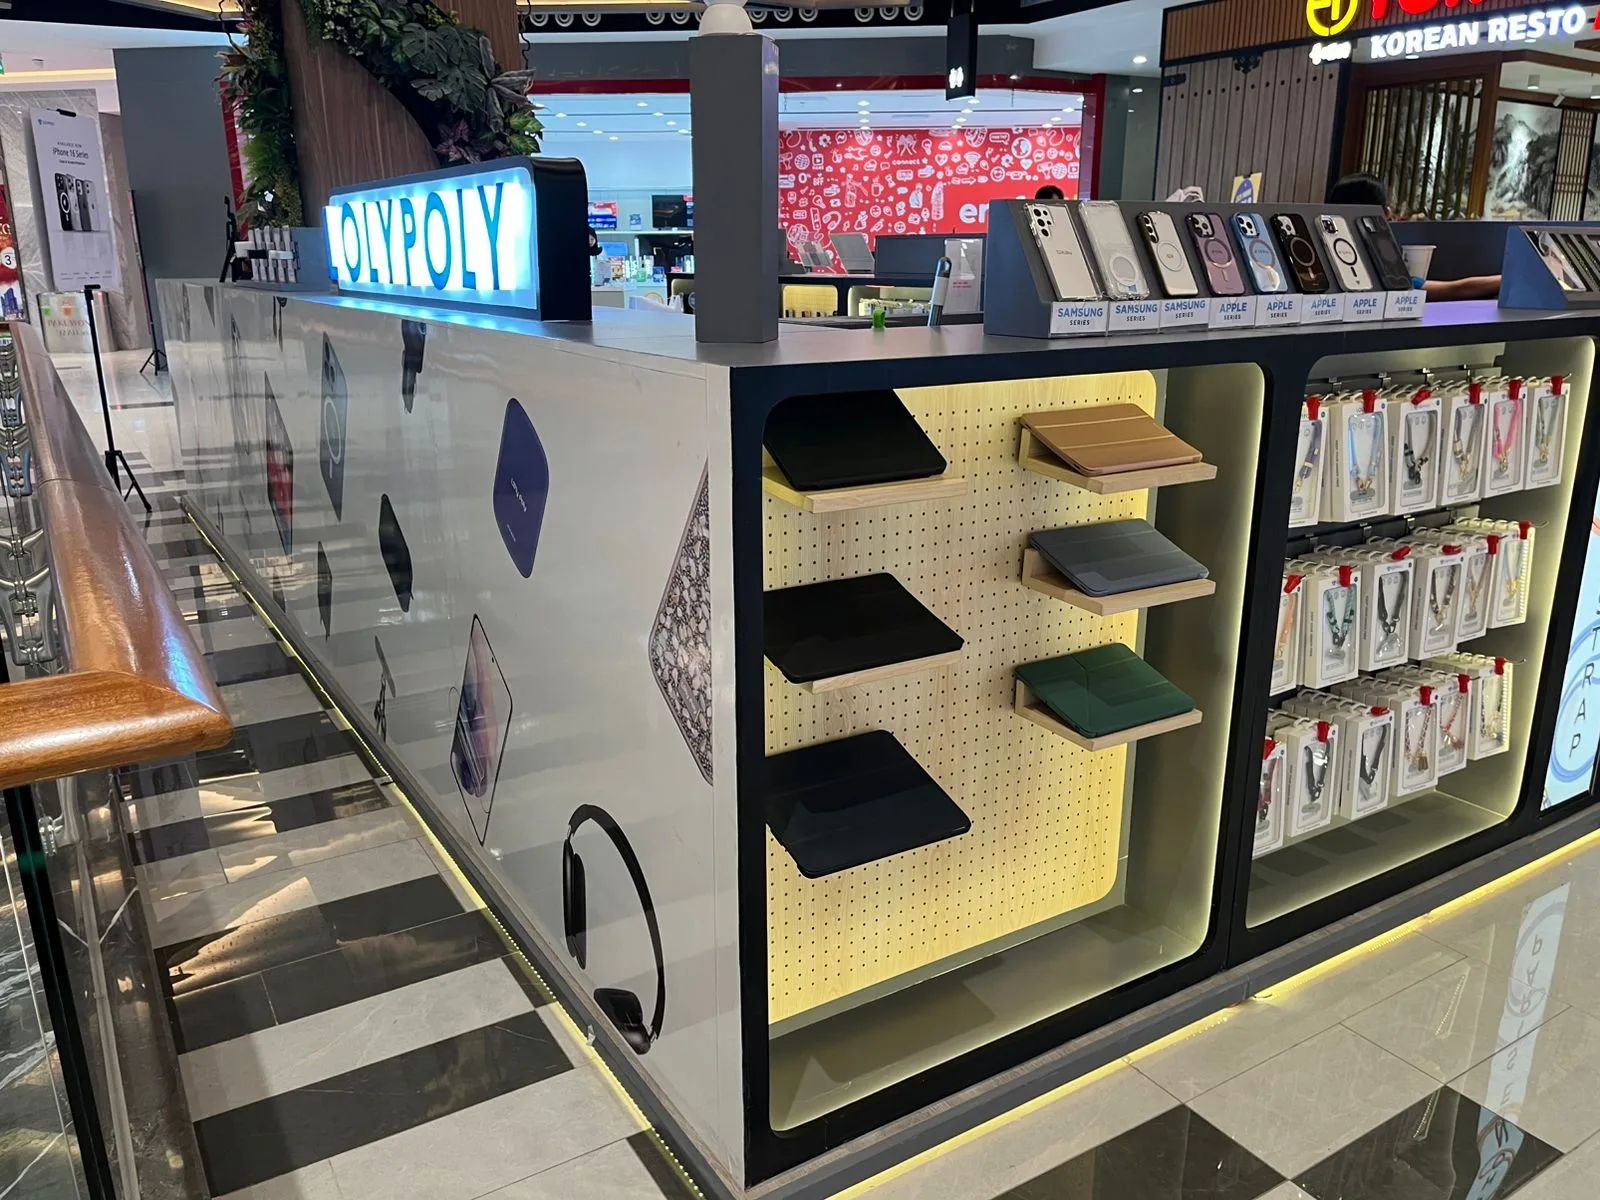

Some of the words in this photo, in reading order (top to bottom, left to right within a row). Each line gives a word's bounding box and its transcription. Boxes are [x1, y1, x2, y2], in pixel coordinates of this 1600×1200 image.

[1370, 20, 1480, 60] KOREAN
[1487, 5, 1587, 44] RESTO
[52, 147, 69, 156] iPhone
[5, 254, 12, 266] 3
[1266, 300, 1293, 311] APPLE
[1310, 298, 1337, 310] APPLE
[1352, 298, 1378, 308] APPLE
[1394, 295, 1418, 305] APPLE
[1115, 303, 1158, 314] SAMSUNG
[1164, 300, 1206, 312] SAMSUNG
[1219, 302, 1247, 313] APPLE
[1057, 307, 1104, 318] SAMSUNG
